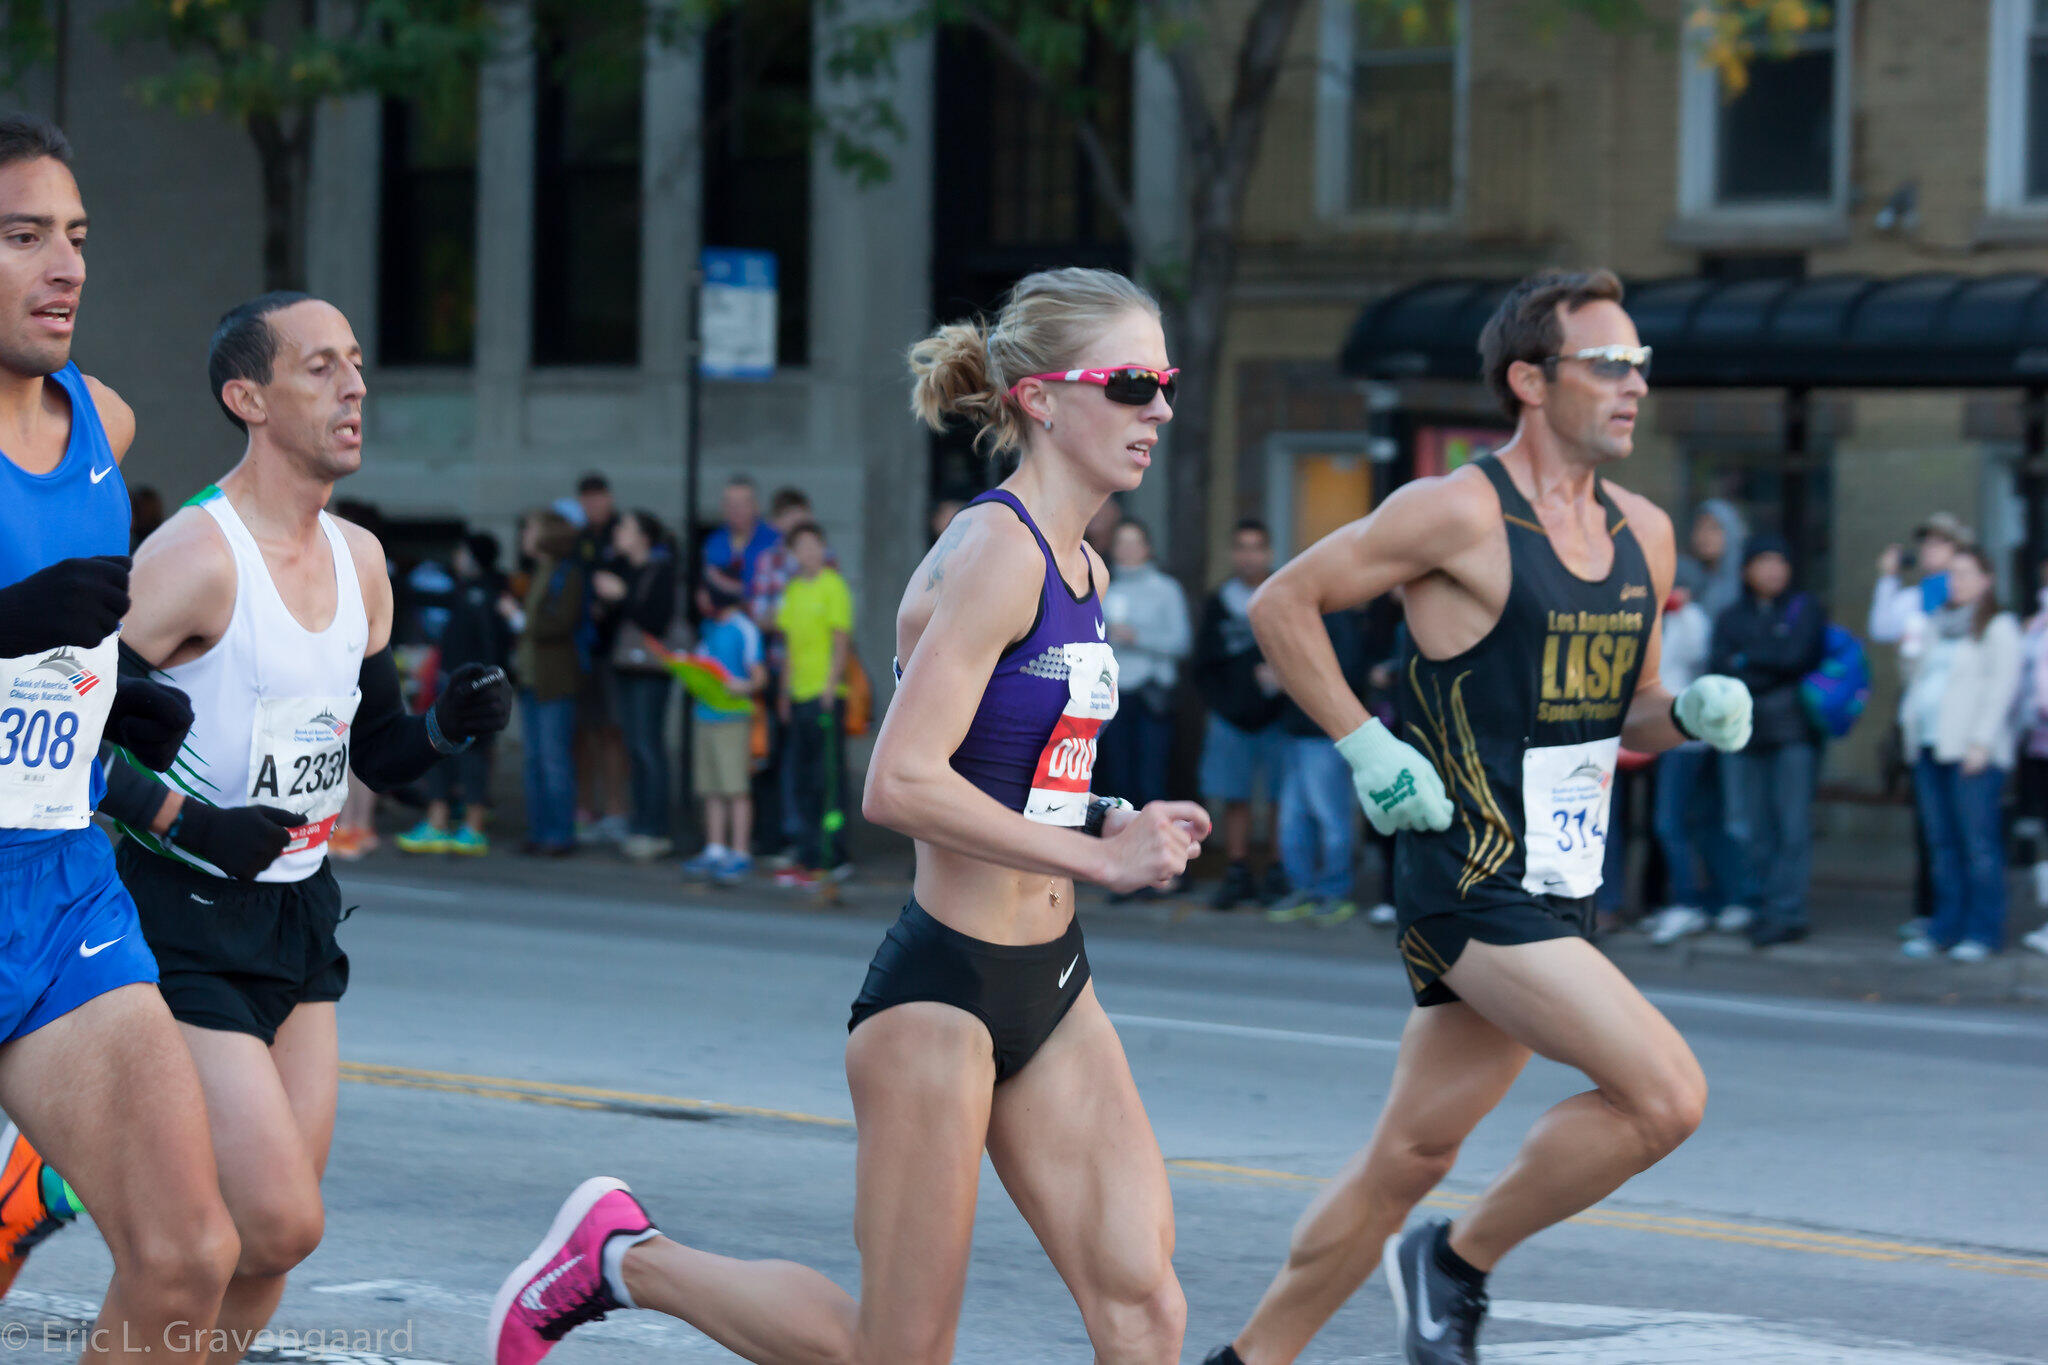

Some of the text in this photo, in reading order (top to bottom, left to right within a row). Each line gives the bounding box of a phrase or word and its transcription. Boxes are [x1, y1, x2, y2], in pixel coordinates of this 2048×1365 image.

[1547, 610, 1643, 633] Los Angeles
[1541, 633, 1639, 699] LASP
[0, 707, 79, 770] 308
[252, 755, 279, 797] A
